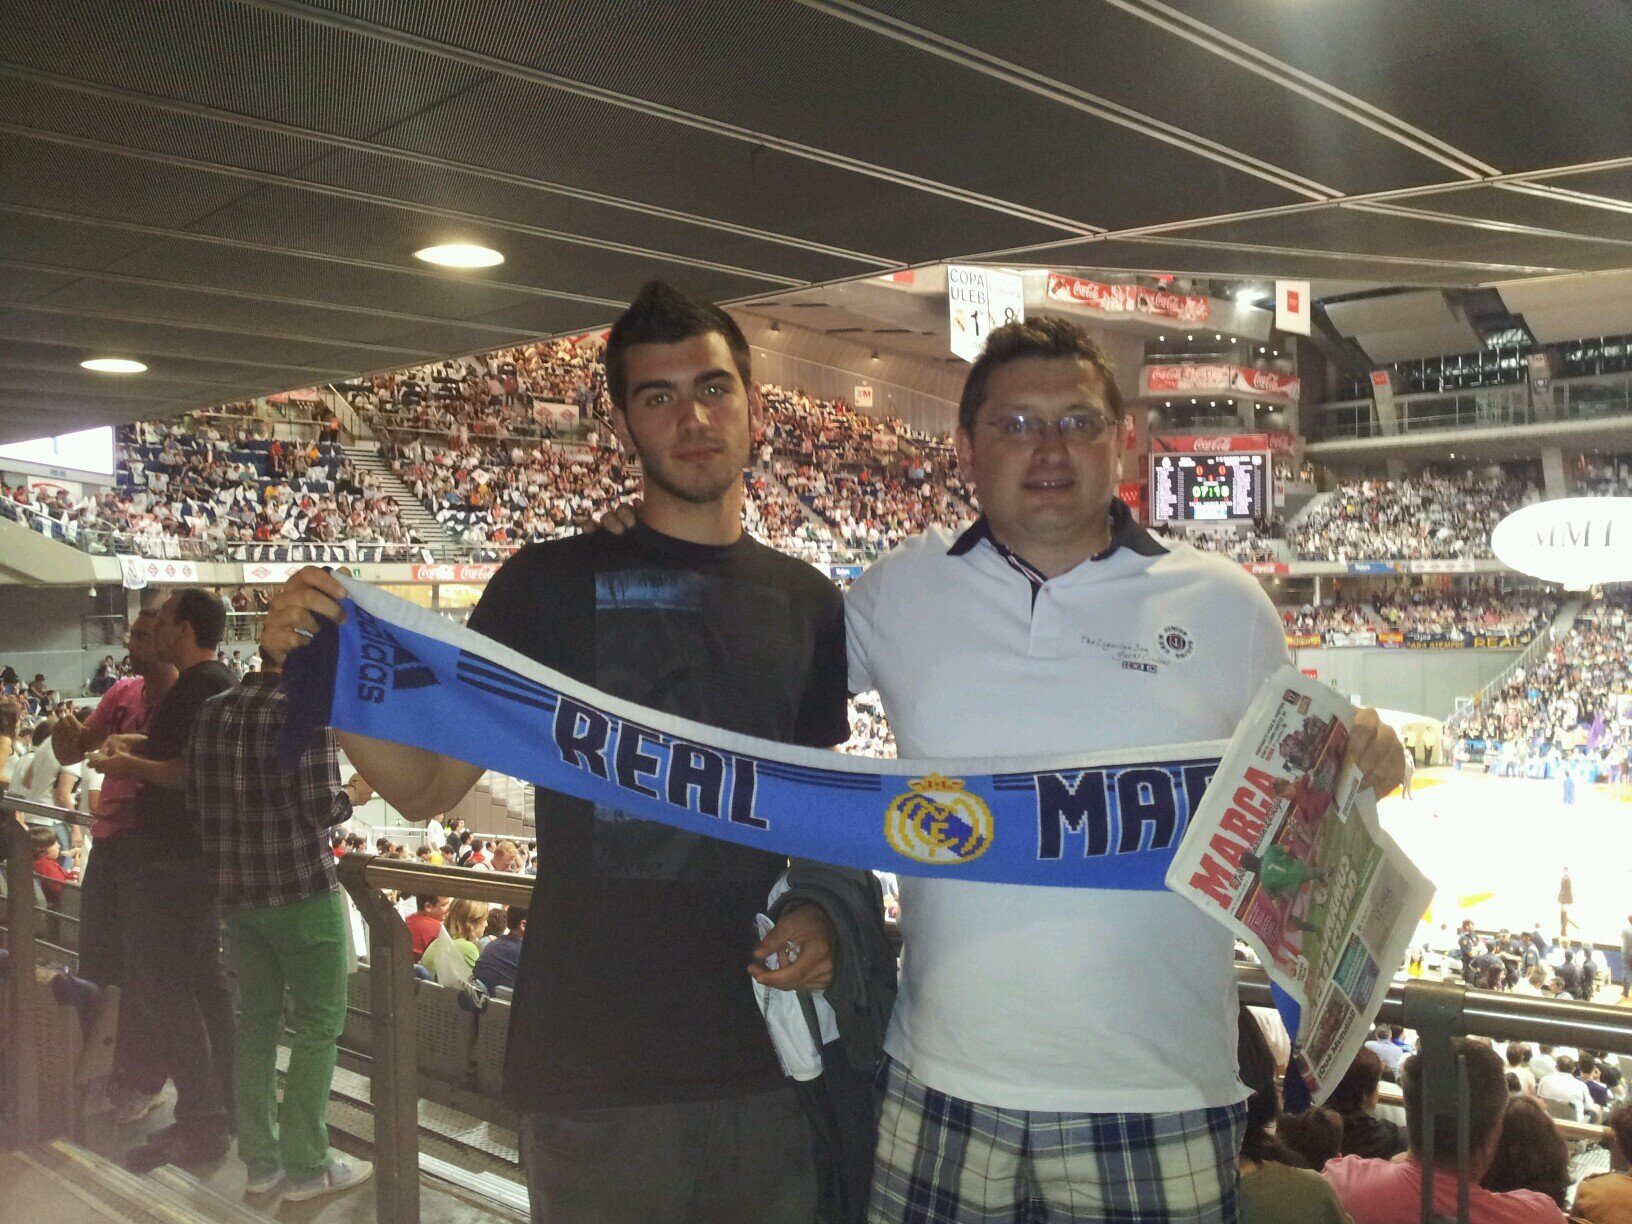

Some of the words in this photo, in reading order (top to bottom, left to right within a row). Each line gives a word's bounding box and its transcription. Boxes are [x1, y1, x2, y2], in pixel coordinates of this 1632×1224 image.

[950, 268, 985, 288] COPA
[951, 285, 986, 305] ULEB
[552, 695, 770, 831] REAL
[1189, 766, 1277, 911] MARCA
